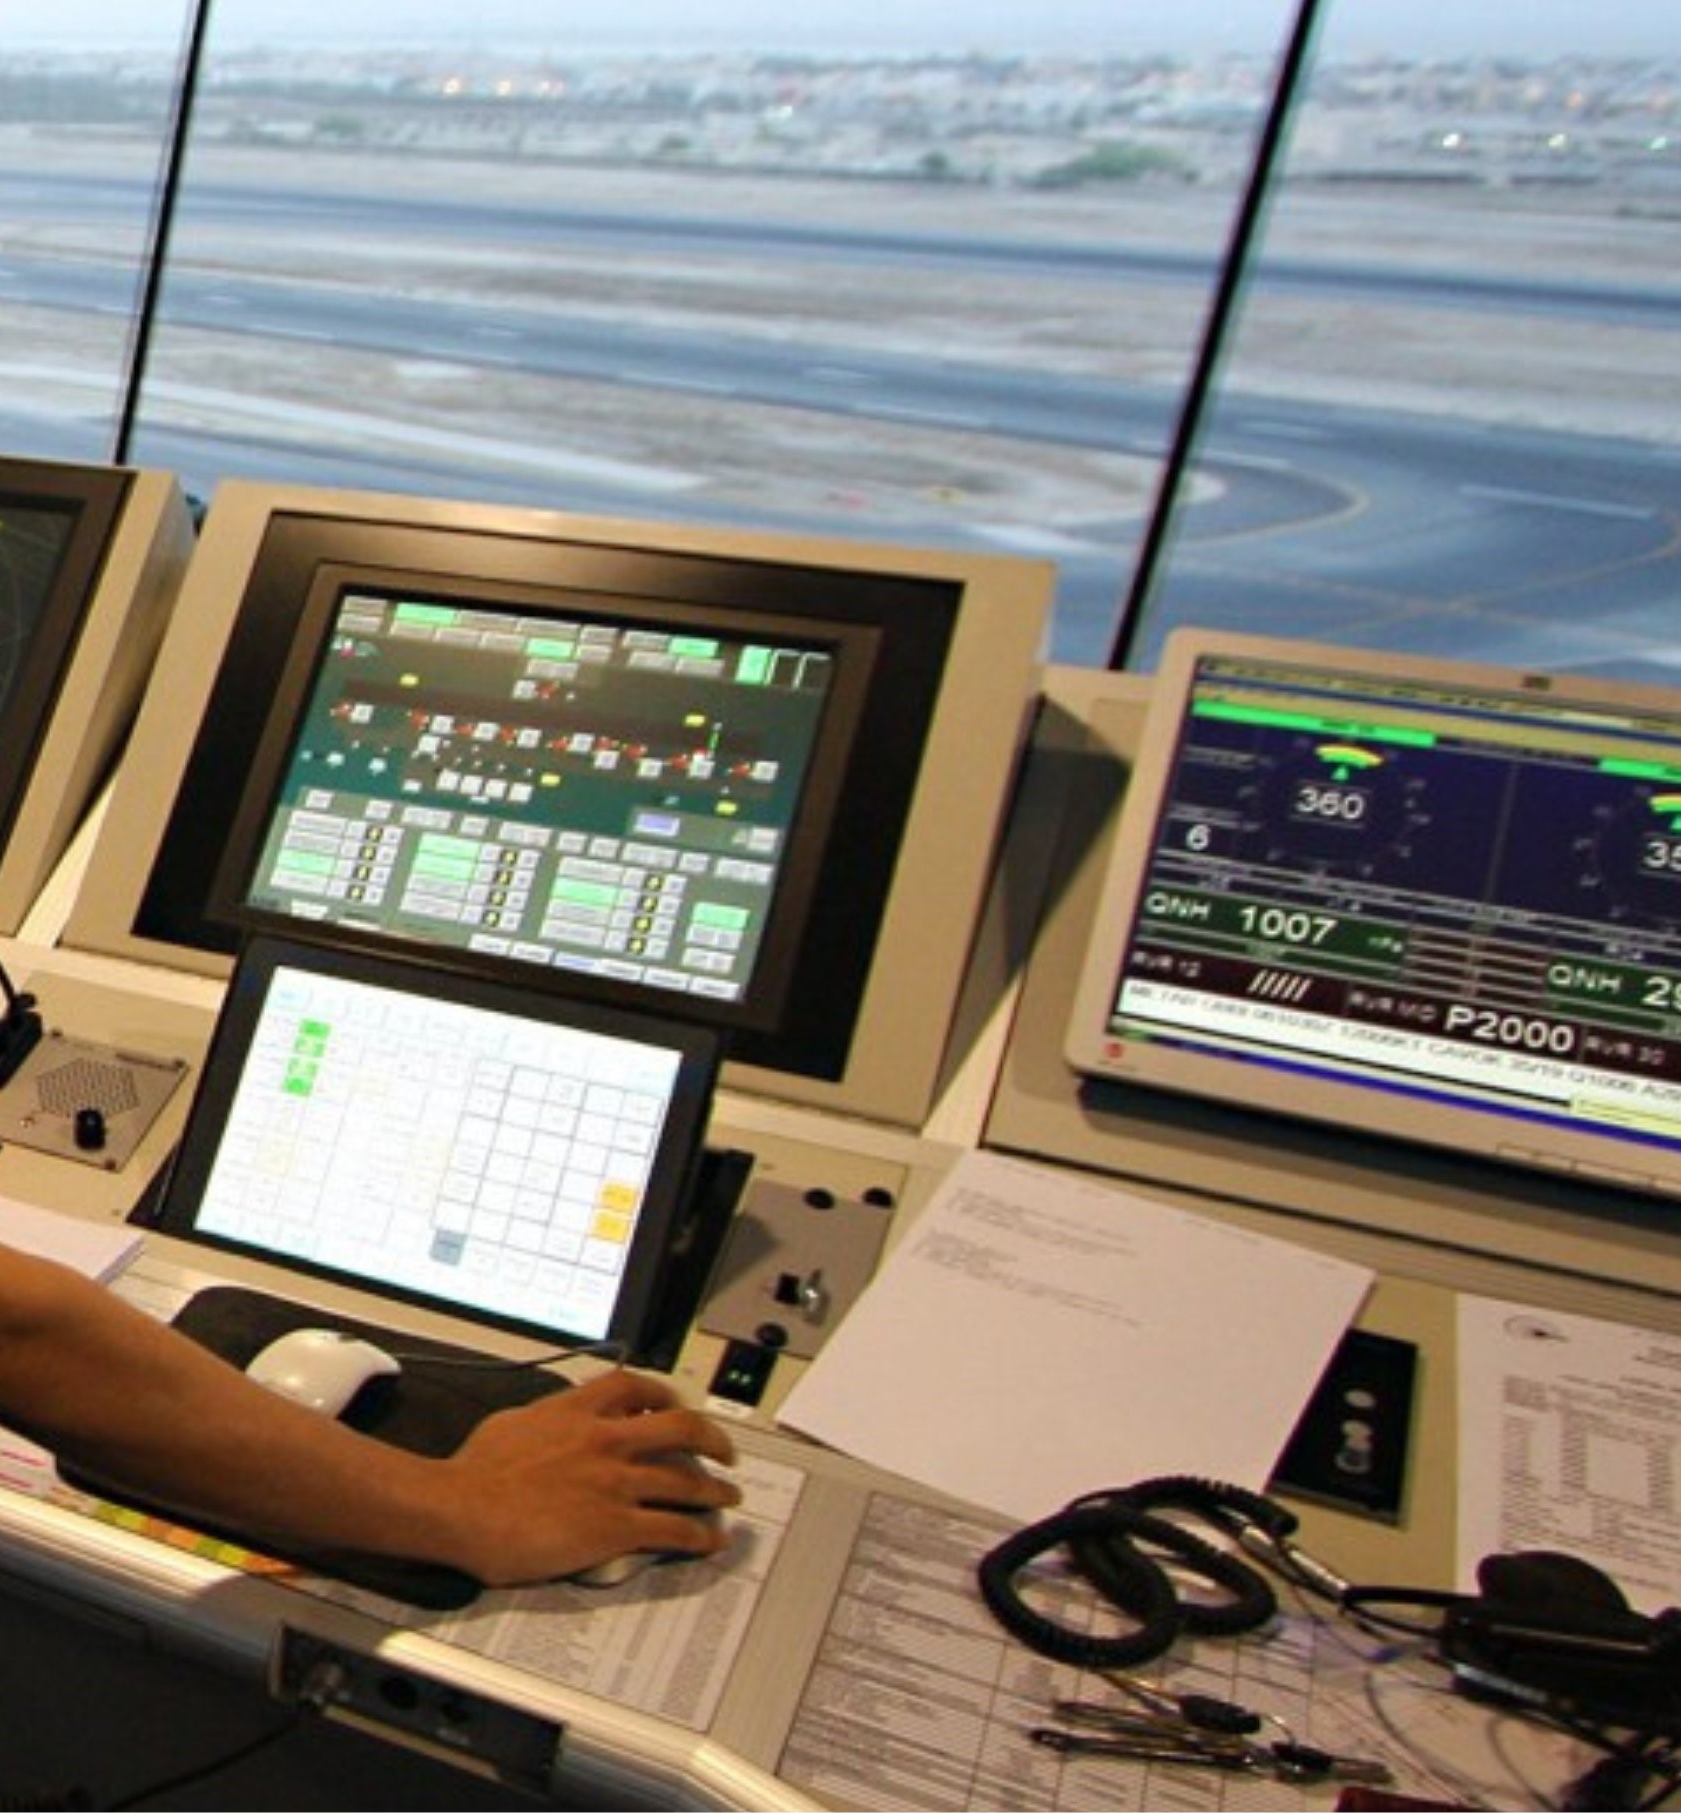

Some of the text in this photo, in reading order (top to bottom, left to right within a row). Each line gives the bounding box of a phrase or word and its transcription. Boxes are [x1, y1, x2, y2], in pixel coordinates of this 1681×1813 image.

[1296, 786, 1364, 820] 360
[1185, 823, 1210, 851] 6
[1145, 892, 1212, 921] QNH
[1240, 904, 1338, 946] 1007
[1548, 964, 1623, 996] QNH
[1445, 1004, 1575, 1051] P2000
